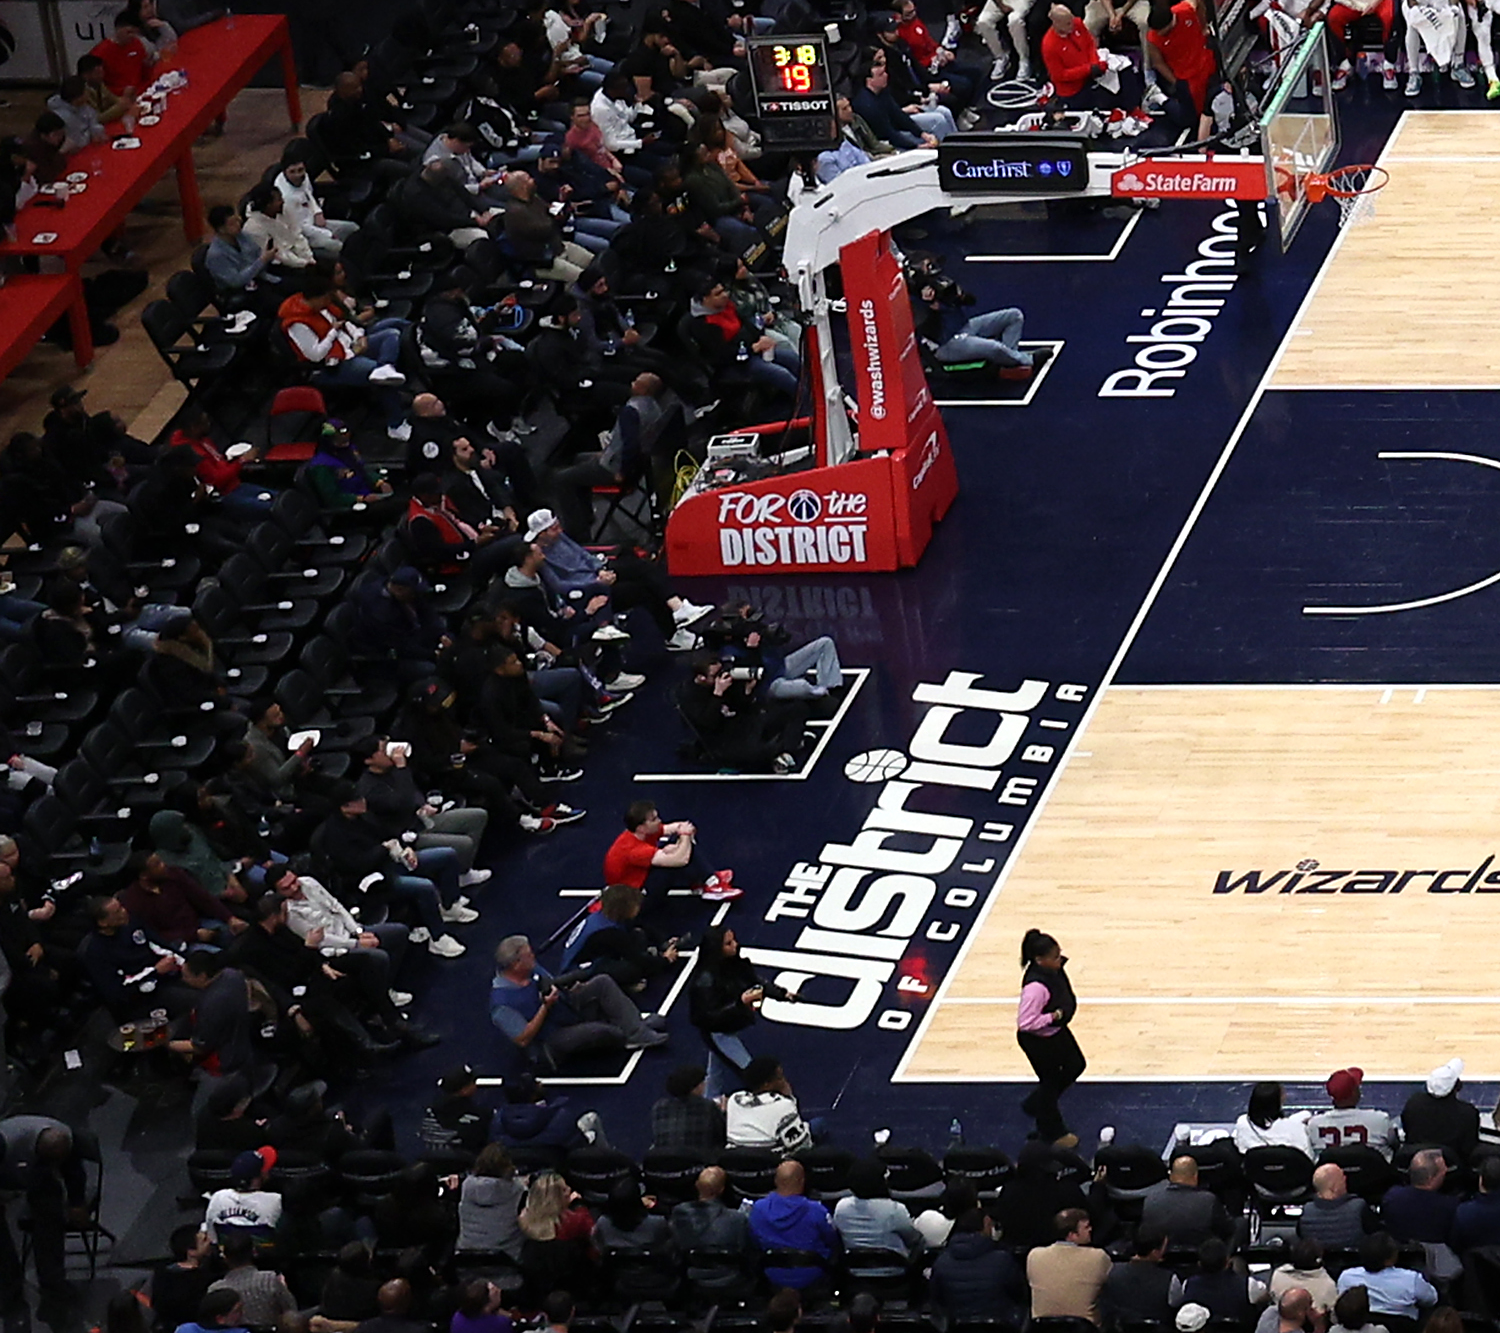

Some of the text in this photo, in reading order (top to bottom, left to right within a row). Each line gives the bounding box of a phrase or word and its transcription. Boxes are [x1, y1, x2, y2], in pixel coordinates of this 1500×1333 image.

[773, 45, 816, 66] 3:18
[784, 65, 810, 91] 19
[781, 100, 829, 111] TISSOT
[952, 160, 1031, 178] CareFirst
[860, 299, 886, 420] @washwizards
[718, 492, 789, 524] FOR
[720, 524, 867, 566] DISTRICT
[766, 862, 834, 922] THE
[877, 974, 928, 1030] OF
